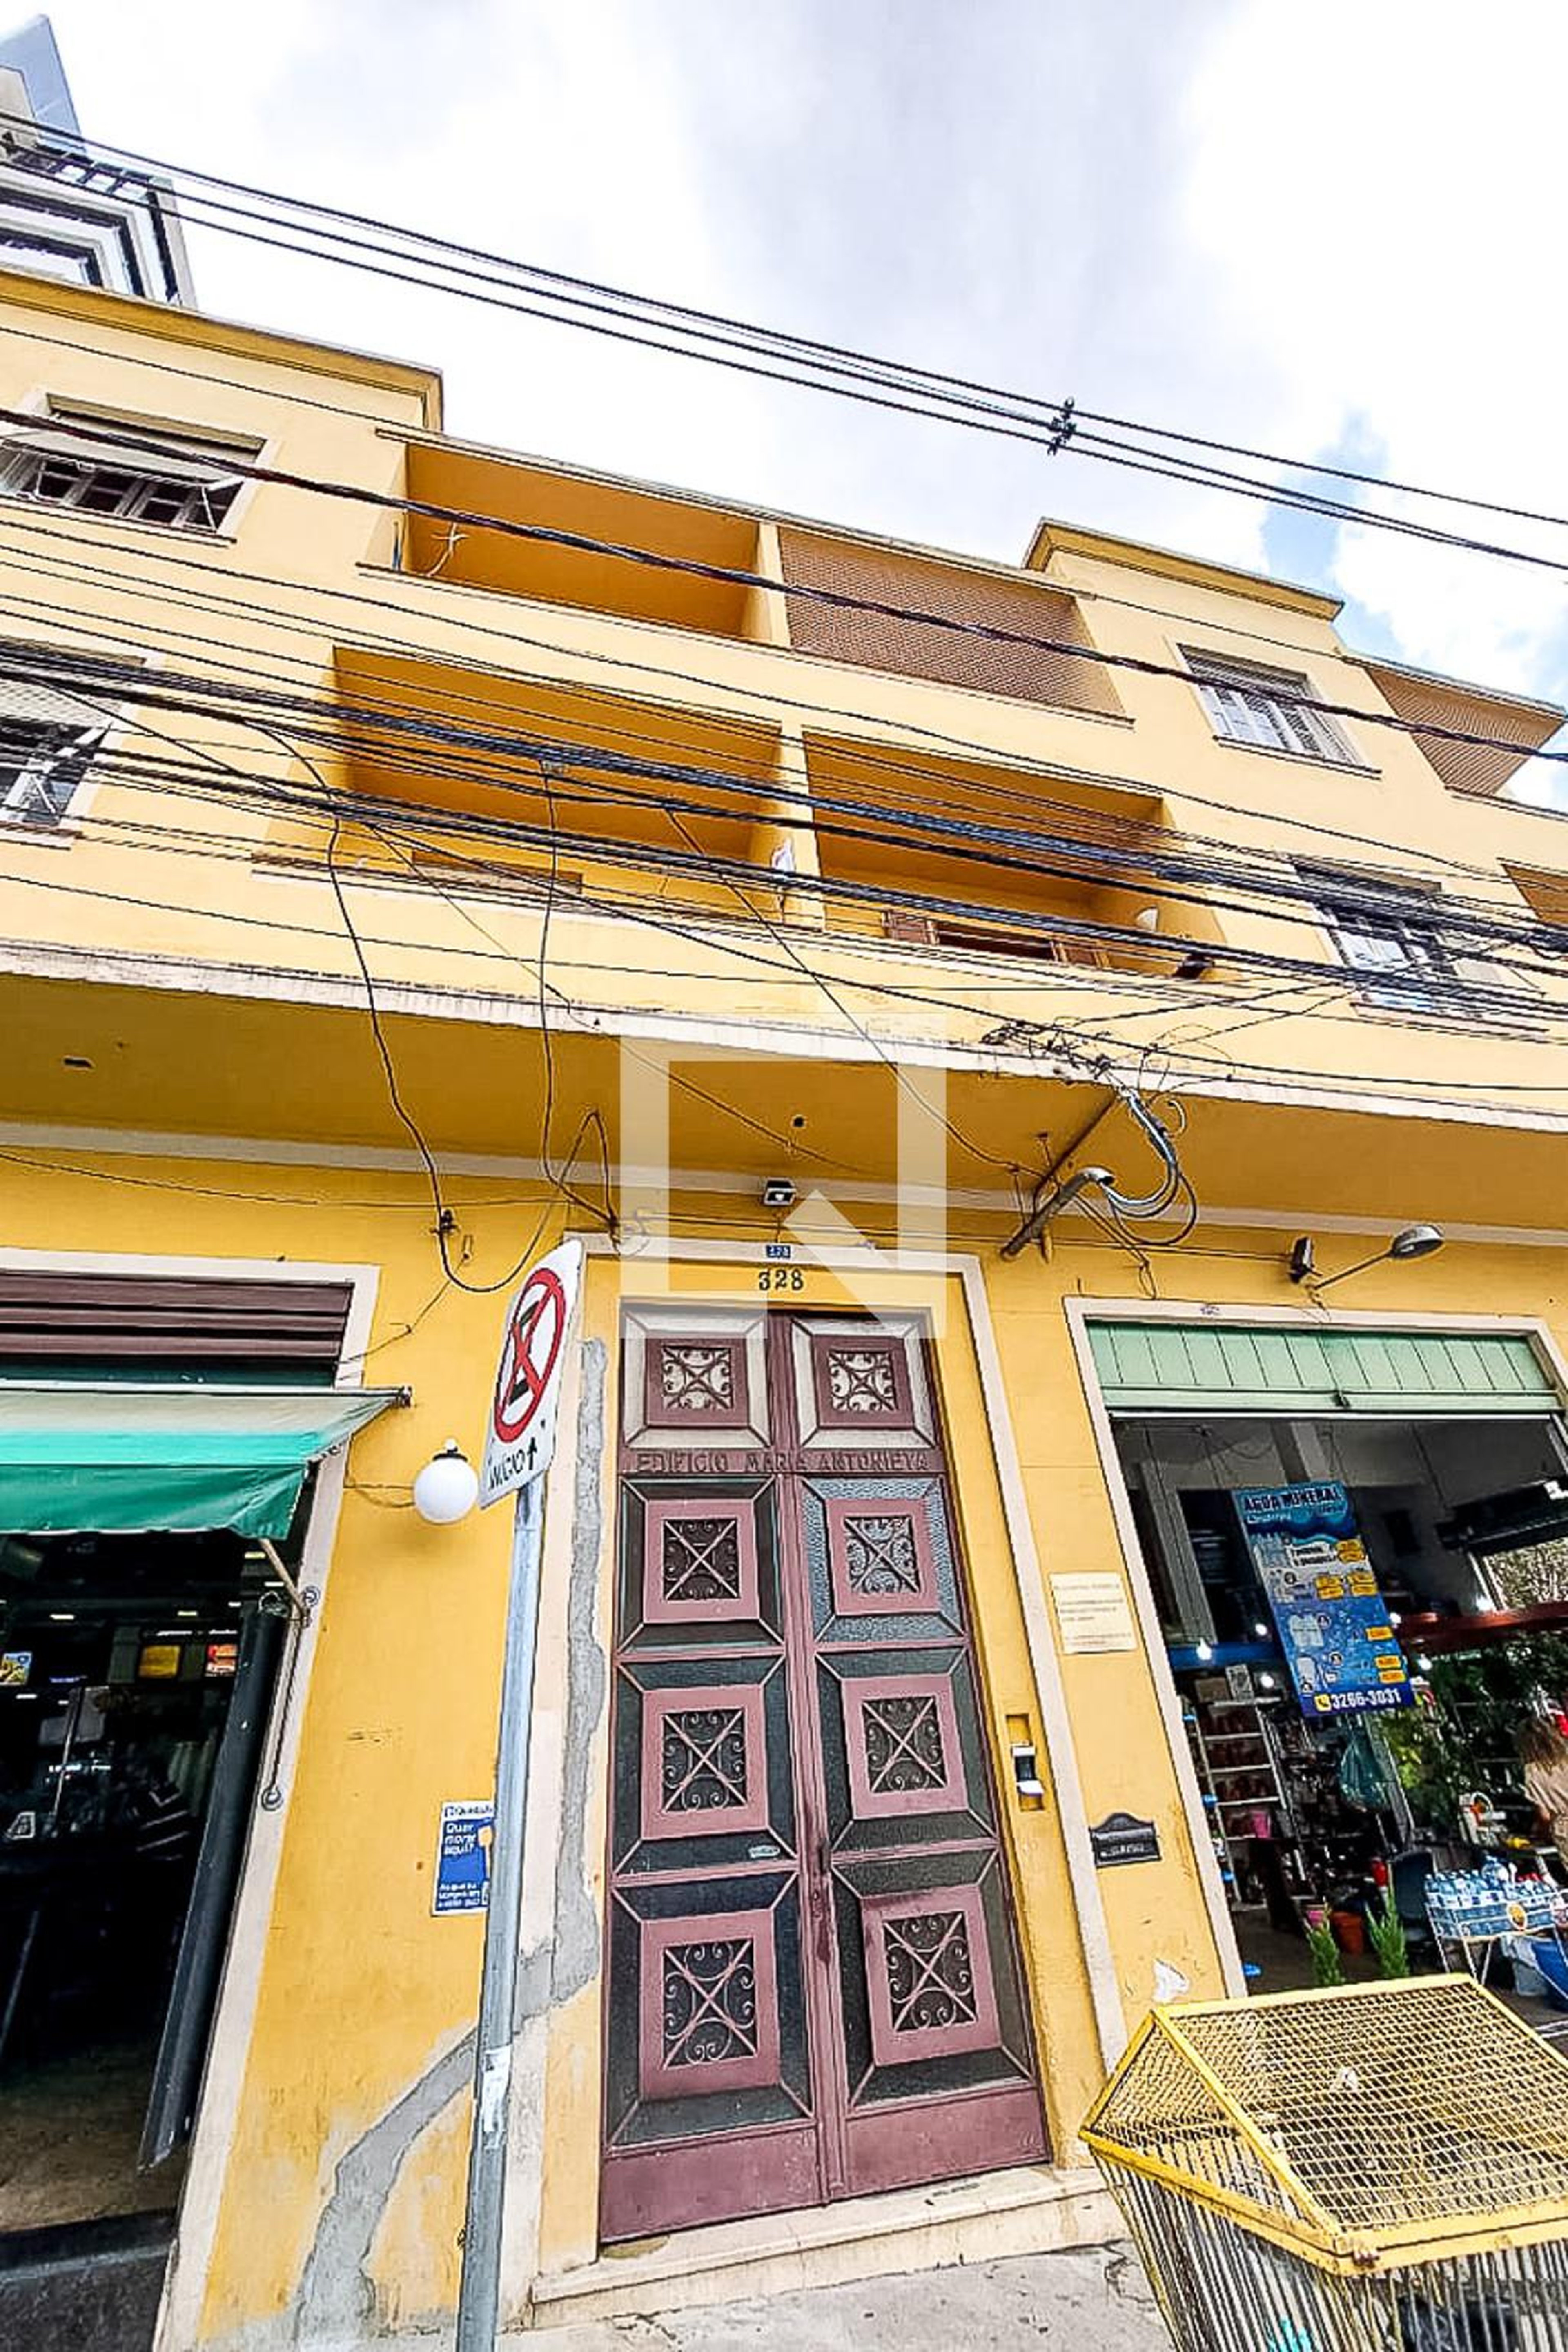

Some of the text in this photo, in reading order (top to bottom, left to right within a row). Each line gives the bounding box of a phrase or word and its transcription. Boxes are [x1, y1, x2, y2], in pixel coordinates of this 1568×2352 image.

[759, 1268, 804, 1291] 328
[745, 1452, 808, 1472] MARIA
[1282, 1488, 1343, 1508] MINERAL
[1331, 1689, 1401, 1710] 3266-3031
